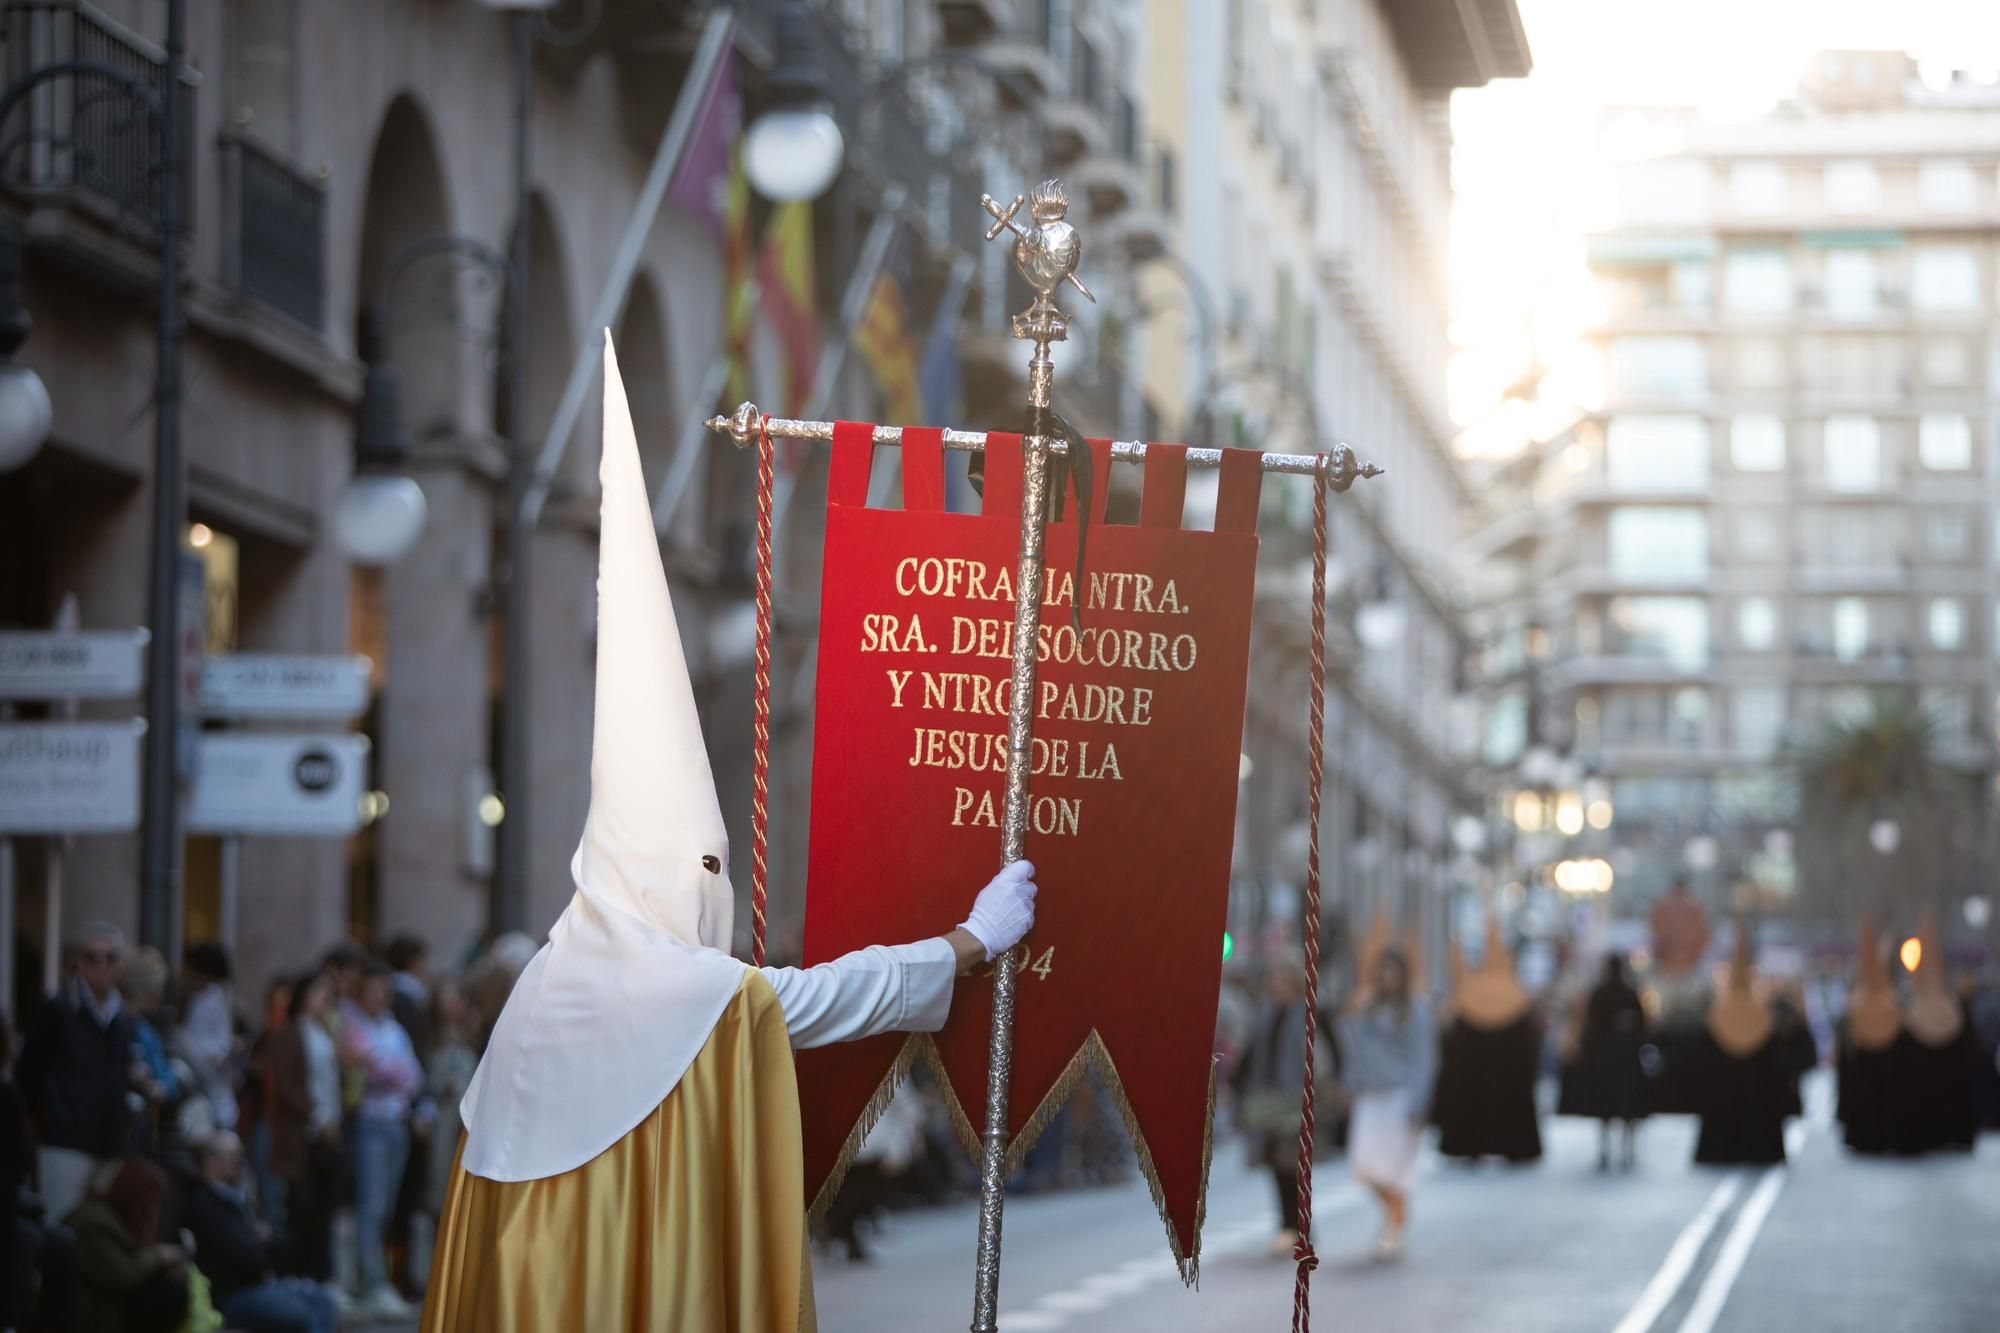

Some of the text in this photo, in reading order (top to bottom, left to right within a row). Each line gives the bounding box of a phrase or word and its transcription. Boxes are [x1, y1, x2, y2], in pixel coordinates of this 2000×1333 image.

[896, 557, 1190, 614] COFRAIA NTRA.
[860, 614, 938, 653] SRA.
[1037, 624, 1197, 672] SOCORRO
[886, 670, 914, 709] Y
[1040, 681, 1154, 726] PADRE
[909, 728, 1124, 781] JESUS DE LA
[951, 786, 1083, 838] PAION
